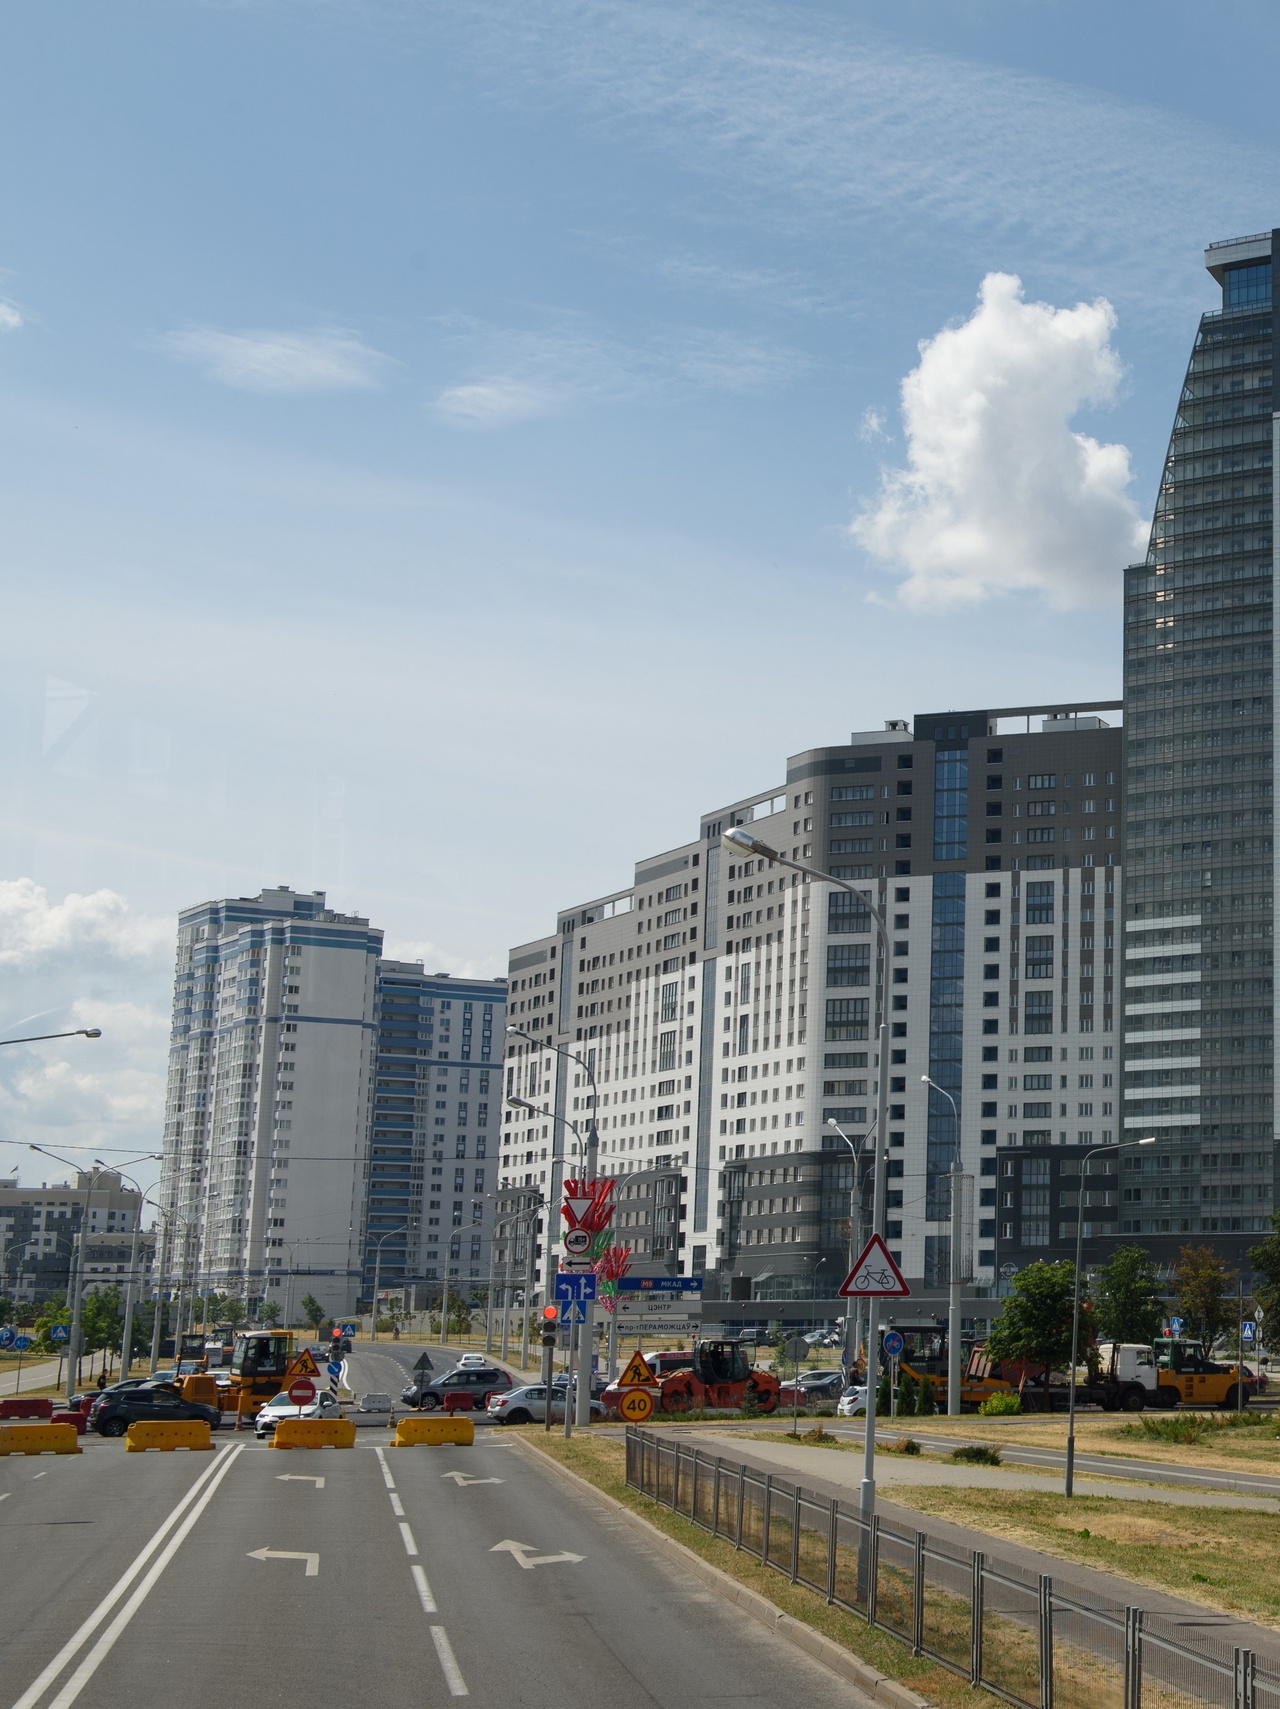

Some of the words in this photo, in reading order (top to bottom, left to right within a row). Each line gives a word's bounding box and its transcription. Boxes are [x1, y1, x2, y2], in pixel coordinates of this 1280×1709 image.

[660, 1280, 682, 1288] МКАД
[647, 1304, 672, 1312] ЦЭНТР
[639, 1322, 691, 1331] ПЕРАМОЖЦАЎ
[3, 1331, 10, 1340] P
[626, 1398, 647, 1412] 40
